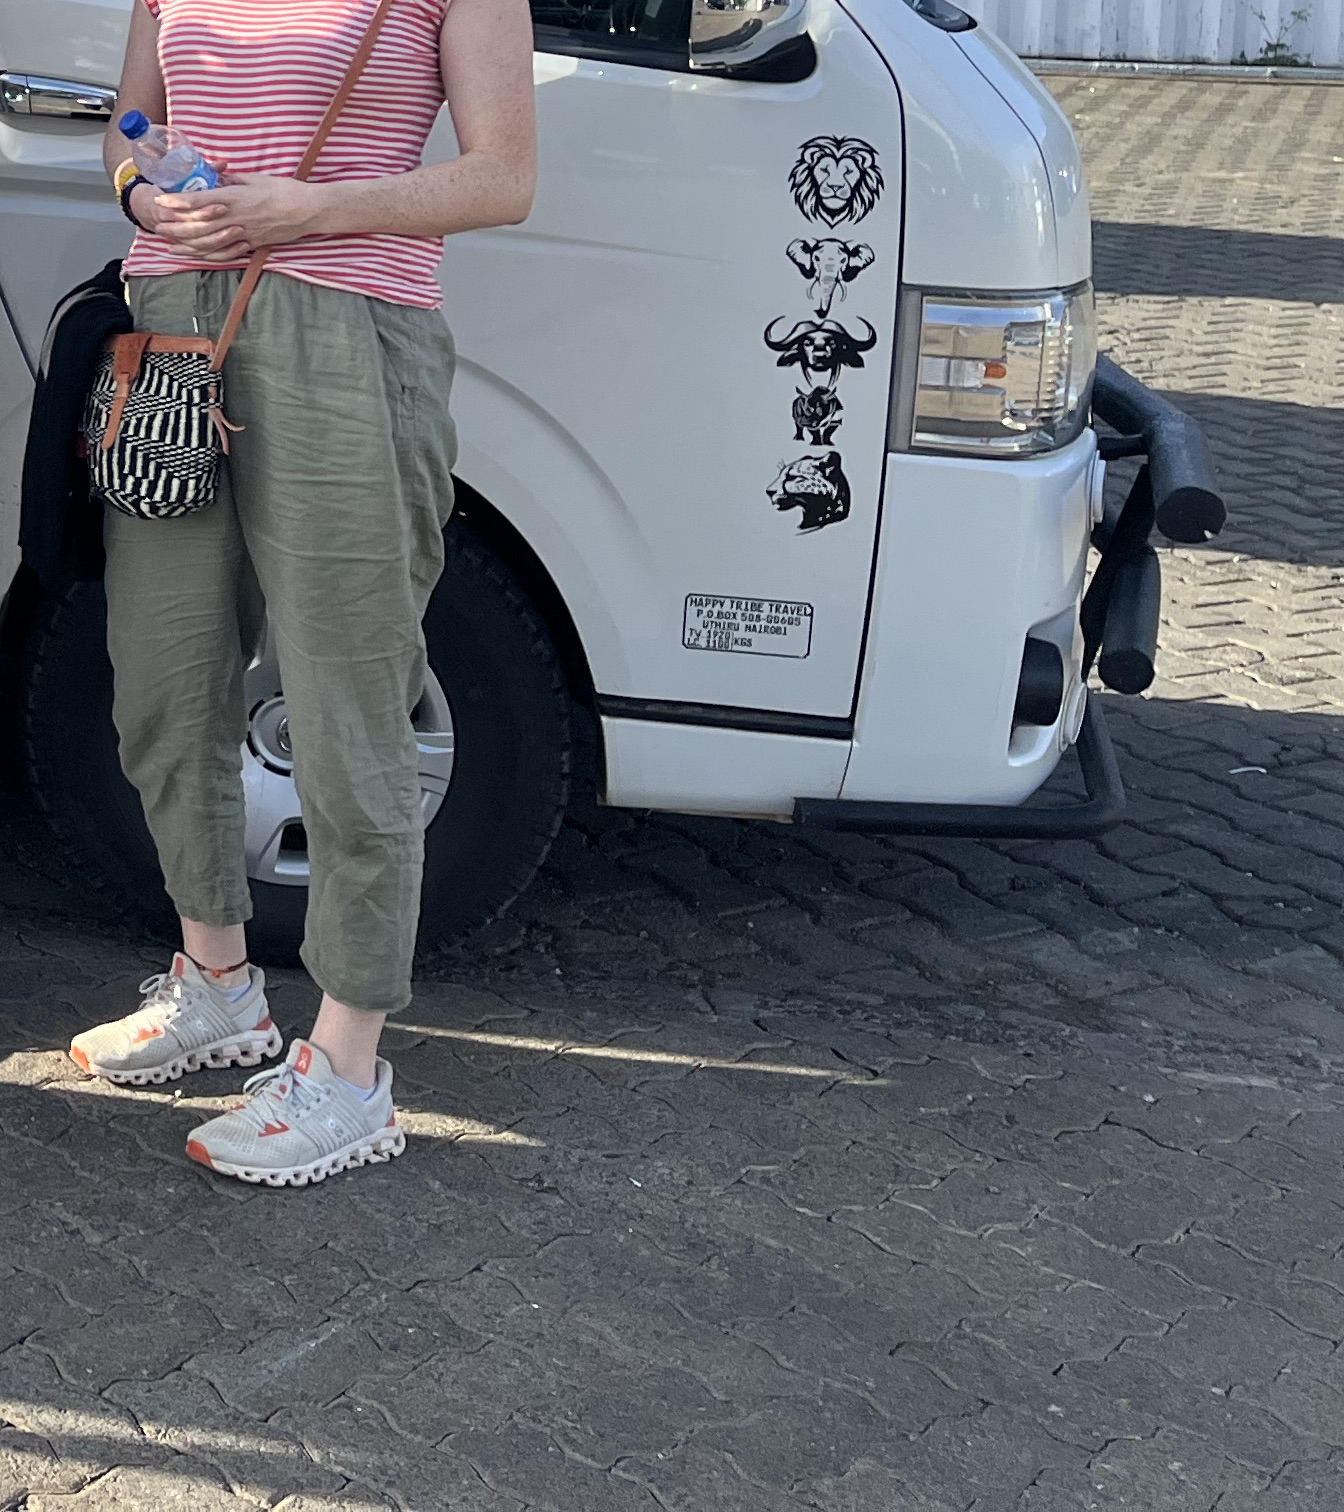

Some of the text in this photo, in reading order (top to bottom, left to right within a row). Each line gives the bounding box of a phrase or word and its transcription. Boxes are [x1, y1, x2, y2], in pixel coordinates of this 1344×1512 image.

[689, 597, 812, 618] HAPPY TRIBE TRAVEL
[744, 623, 788, 636] NAIROBI
[733, 637, 753, 648] KGS
